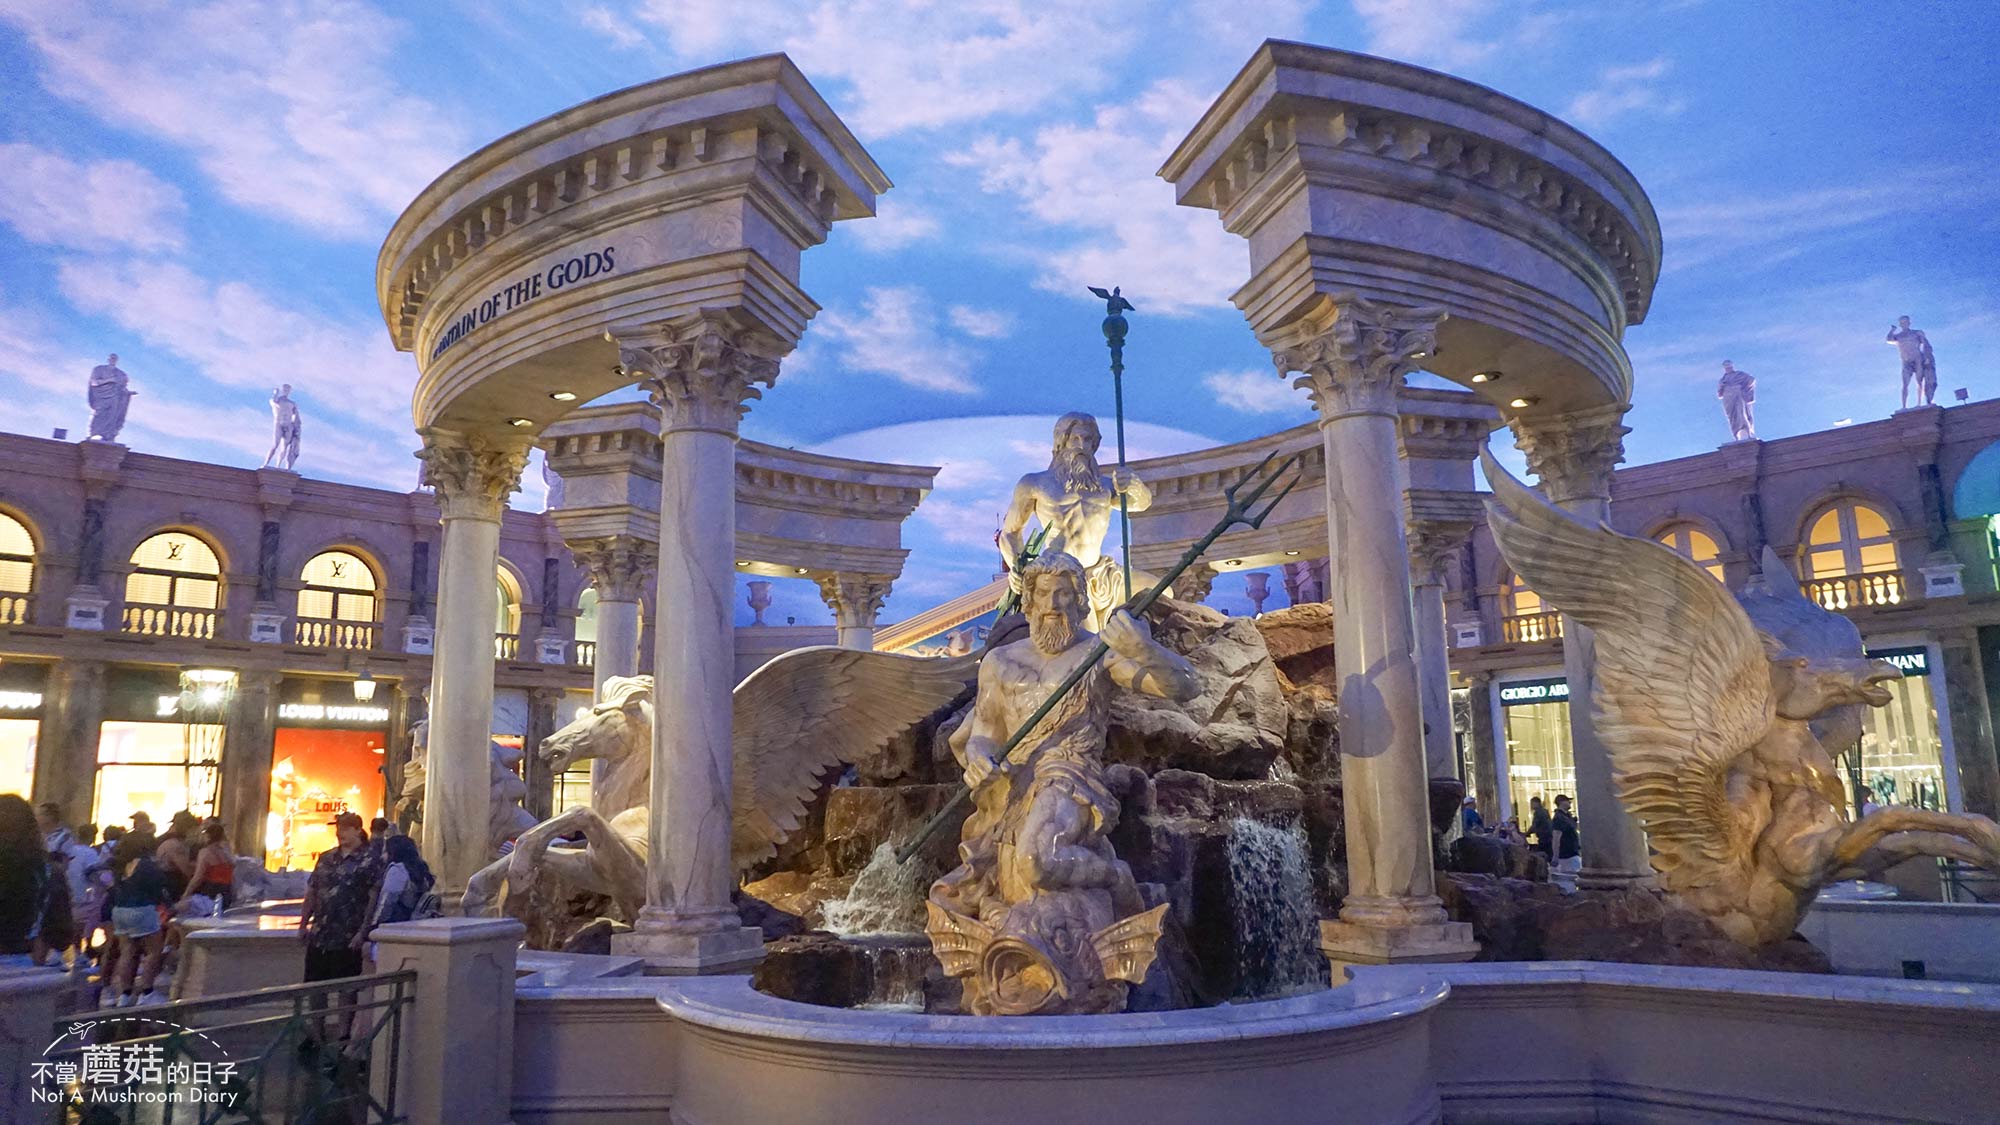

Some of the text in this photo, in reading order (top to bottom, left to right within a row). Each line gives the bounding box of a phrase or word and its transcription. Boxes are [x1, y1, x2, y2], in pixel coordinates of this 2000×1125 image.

[480, 292, 501, 323] OF
[504, 273, 542, 311] THE
[547, 246, 615, 290] GODS
[1880, 653, 1926, 670] MANI
[1501, 685, 1547, 700] GIORGIO
[279, 704, 389, 721] LOUIS VUITTON
[315, 801, 348, 813] LOUIS
